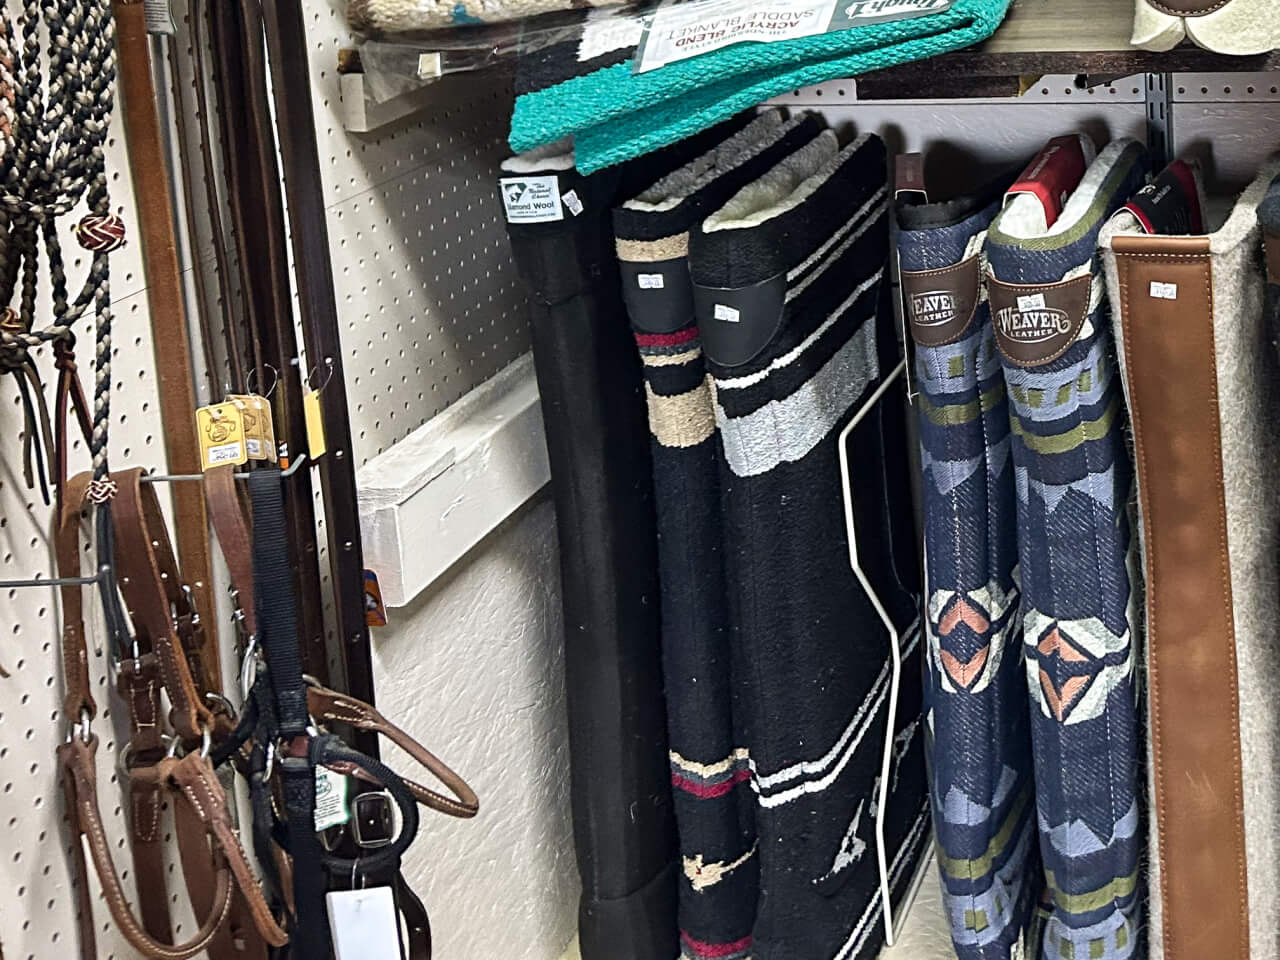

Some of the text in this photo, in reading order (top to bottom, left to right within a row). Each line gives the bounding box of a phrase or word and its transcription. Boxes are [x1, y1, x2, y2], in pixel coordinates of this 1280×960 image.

[667, 16, 741, 40] BLANKET
[675, 31, 726, 47] BLEND
[533, 201, 555, 210] Wool
[995, 307, 1072, 334] WEAVER
[1010, 328, 1053, 338] LEATHER
